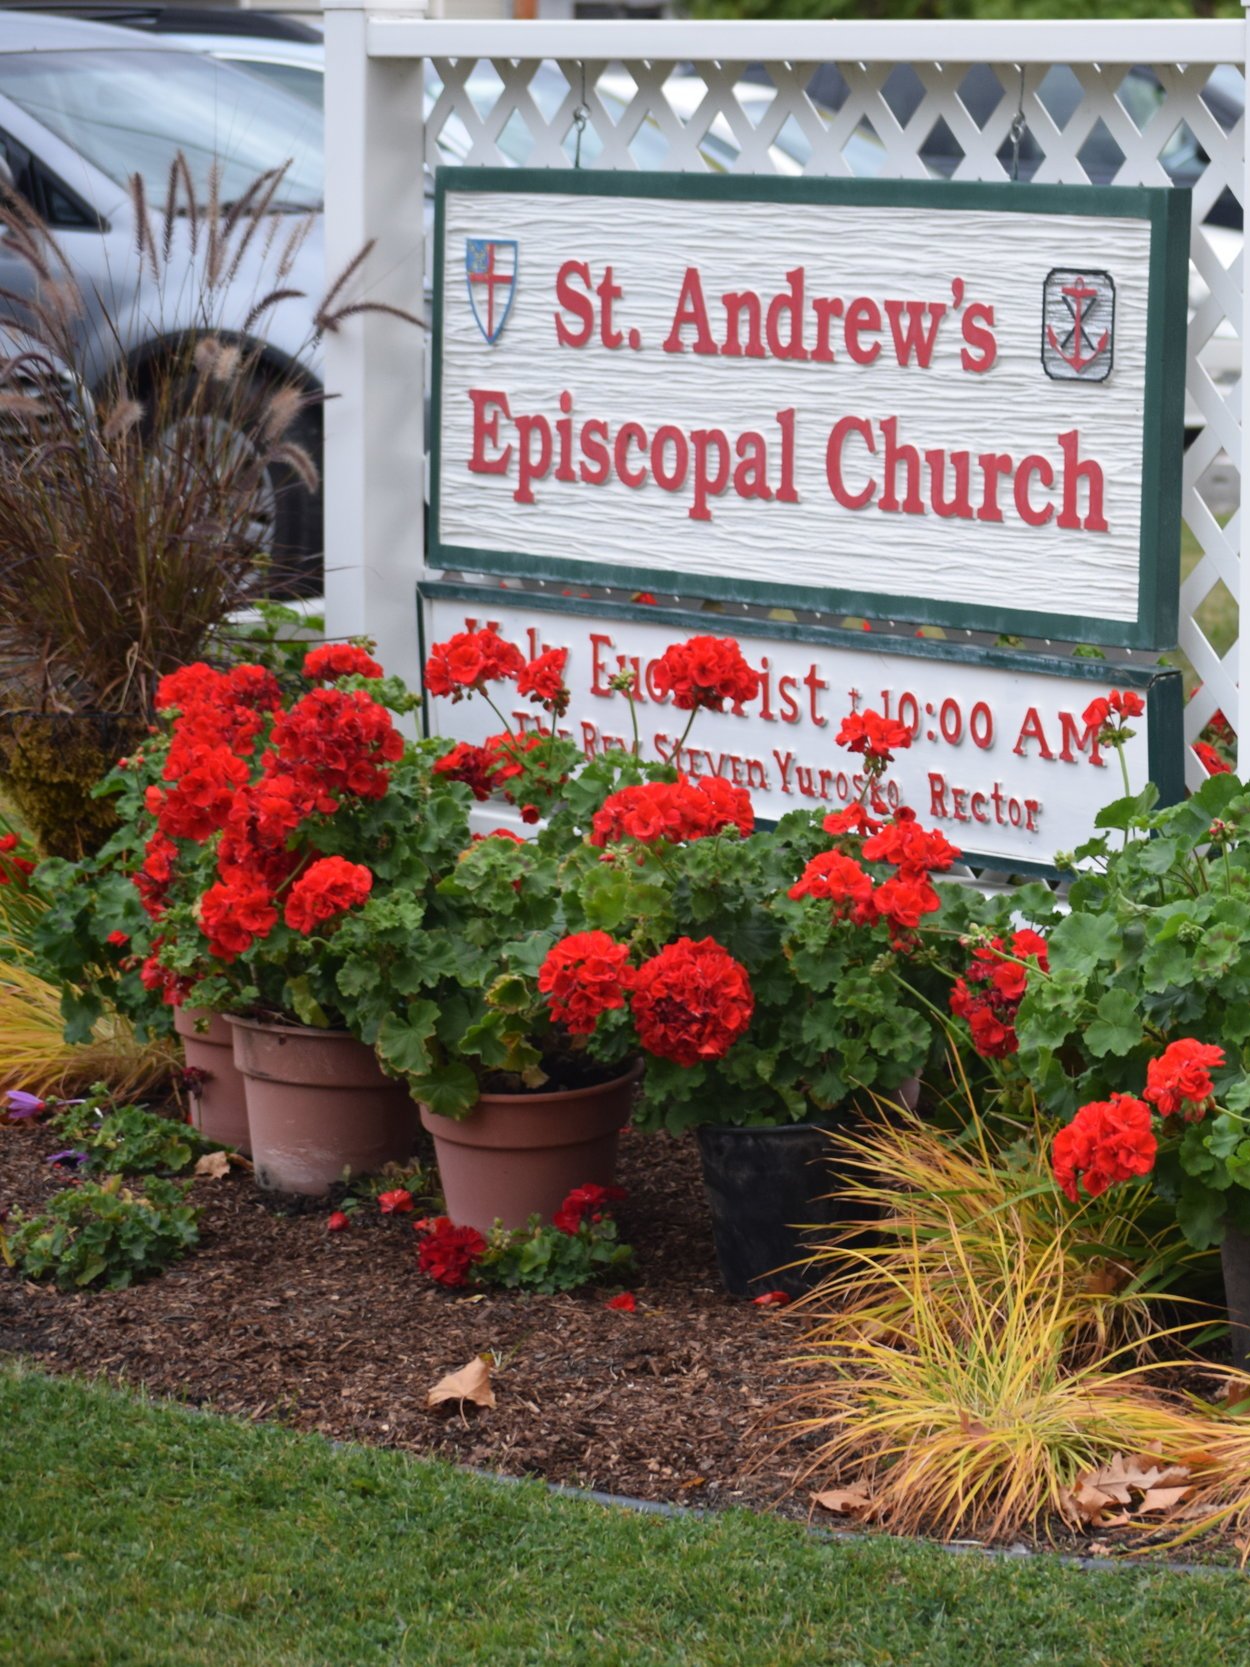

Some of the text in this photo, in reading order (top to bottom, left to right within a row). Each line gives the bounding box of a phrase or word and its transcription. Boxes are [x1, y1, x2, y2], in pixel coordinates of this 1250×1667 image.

[555, 260, 997, 373] St. Andrew's
[468, 389, 1109, 532] Episcopal Church
[589, 633, 828, 726] Eucist
[881, 690, 993, 750] 10:00
[1013, 707, 1104, 767] AM
